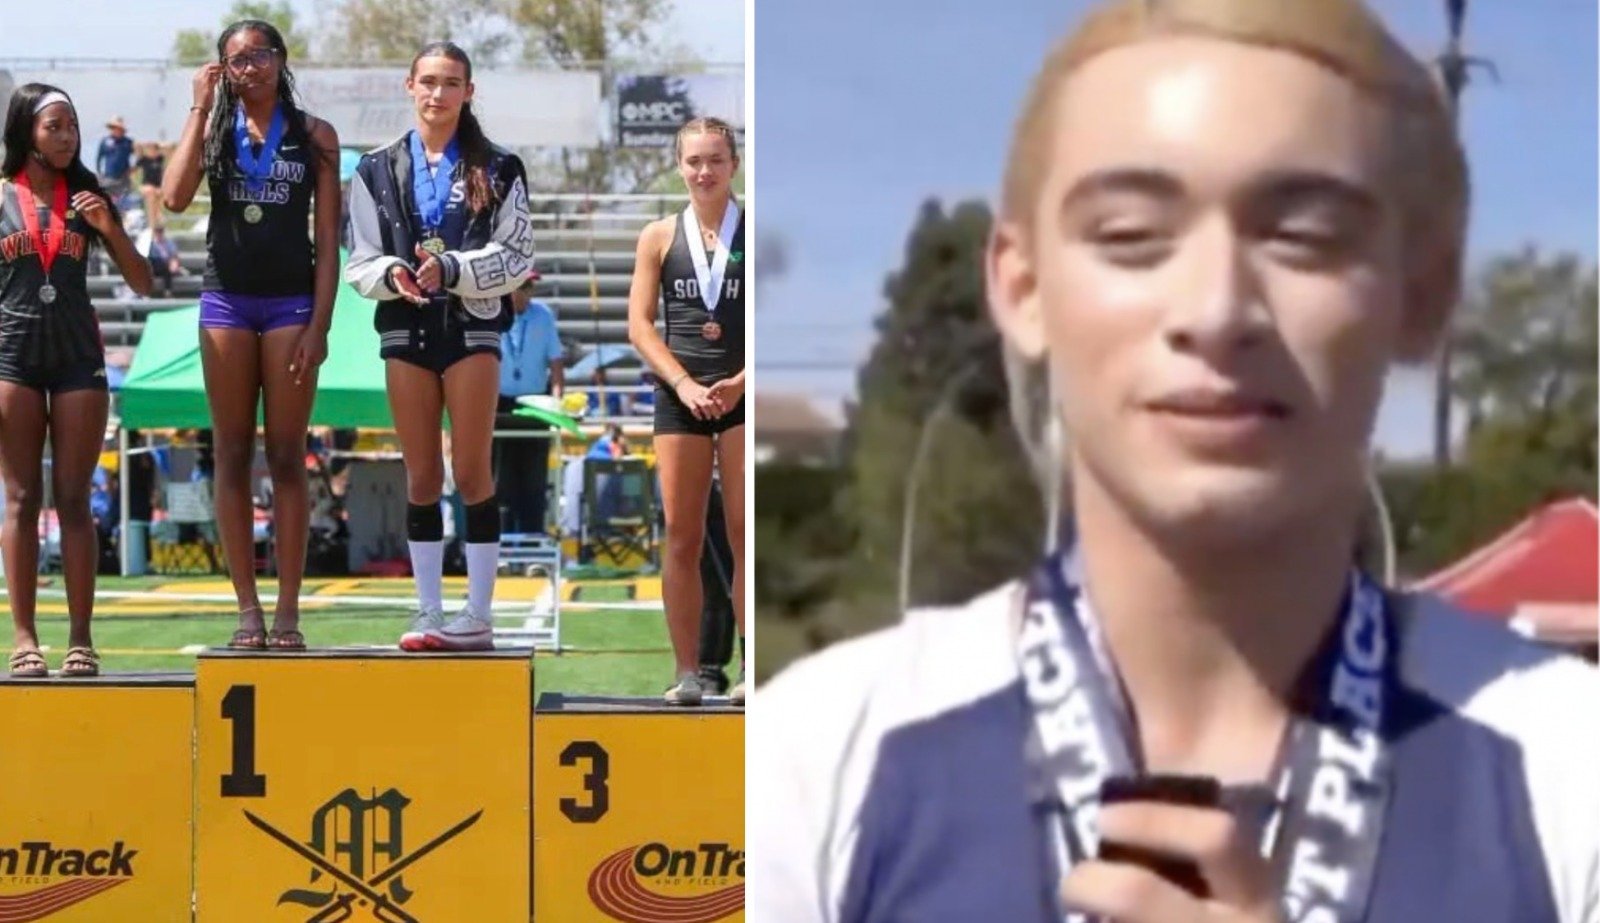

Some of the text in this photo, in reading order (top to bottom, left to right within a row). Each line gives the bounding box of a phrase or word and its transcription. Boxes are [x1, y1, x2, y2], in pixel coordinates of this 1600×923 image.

[674, 278, 740, 300] SOH
[220, 684, 267, 798] 1
[559, 740, 610, 824] 3
